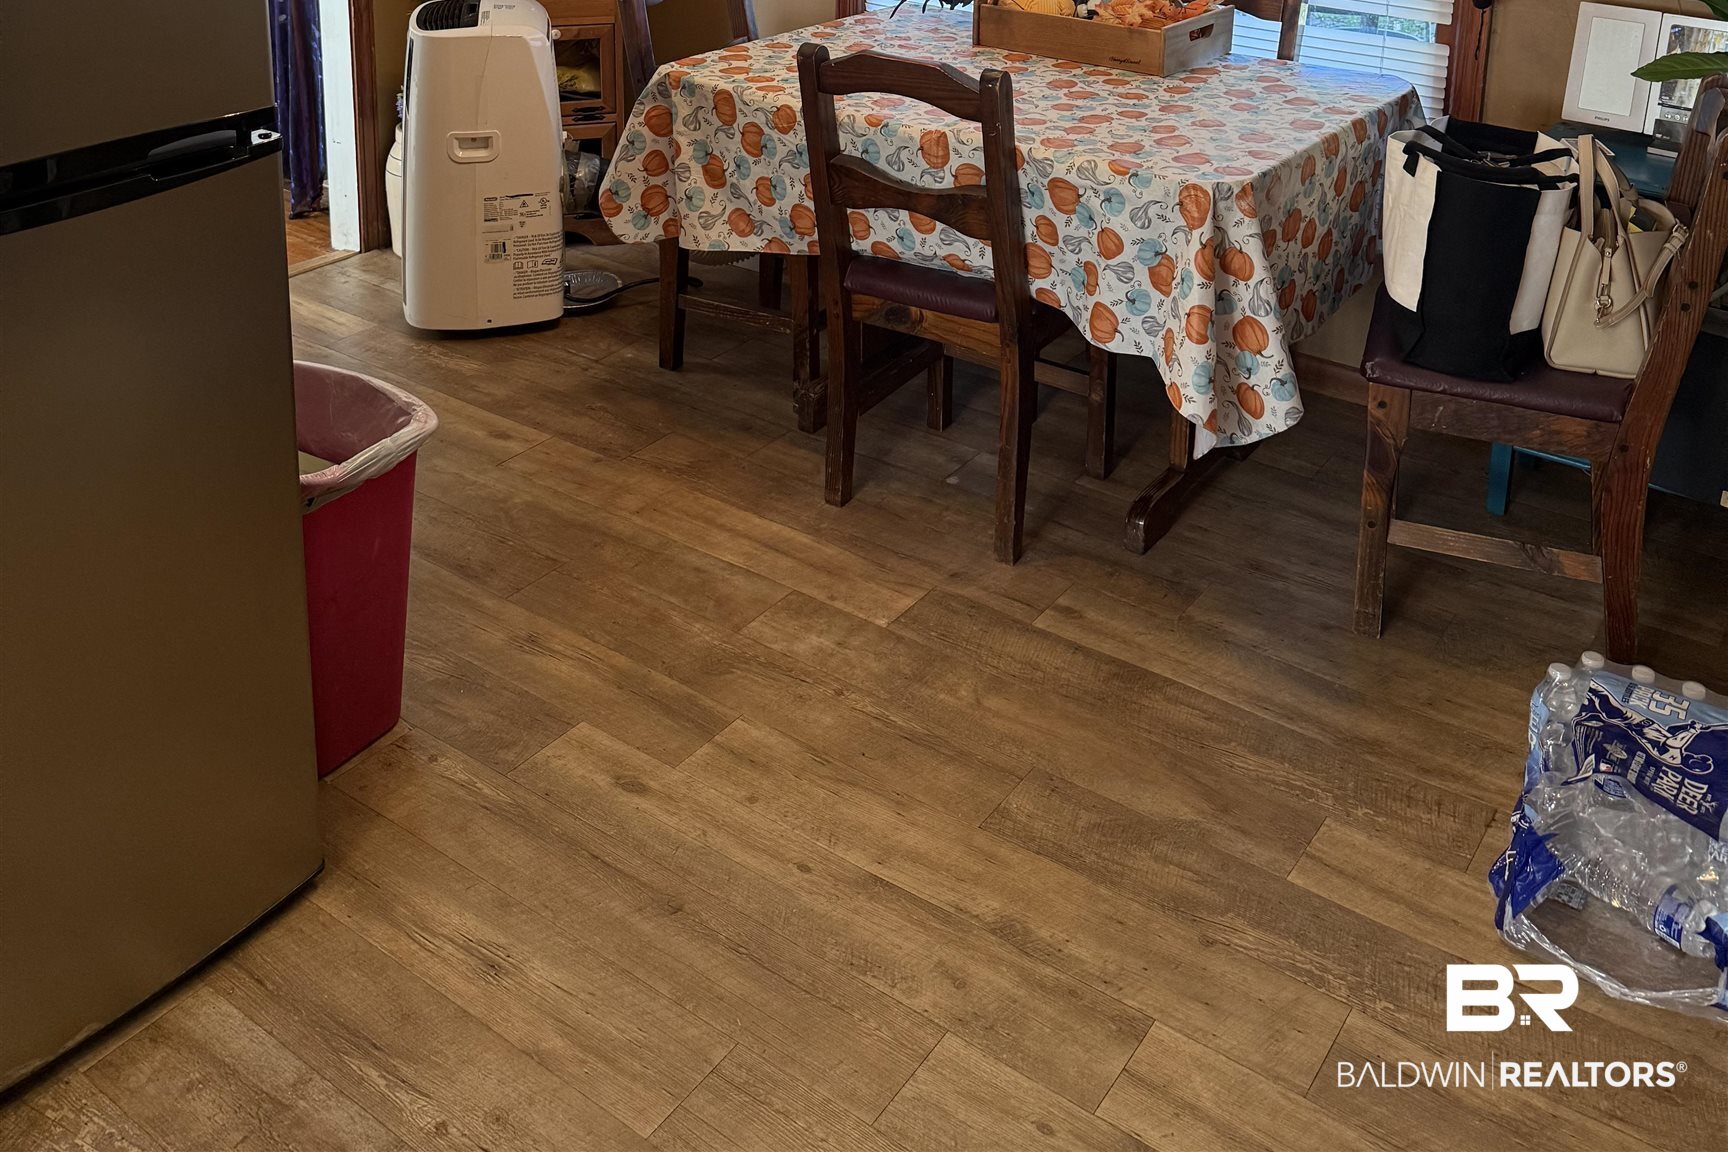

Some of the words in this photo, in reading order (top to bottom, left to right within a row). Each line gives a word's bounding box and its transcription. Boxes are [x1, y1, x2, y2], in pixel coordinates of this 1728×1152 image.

[1628, 685, 1654, 709] PACK
[1649, 691, 1691, 720] 35
[1651, 766, 1683, 804] PARK
[1676, 778, 1709, 815] DEER
